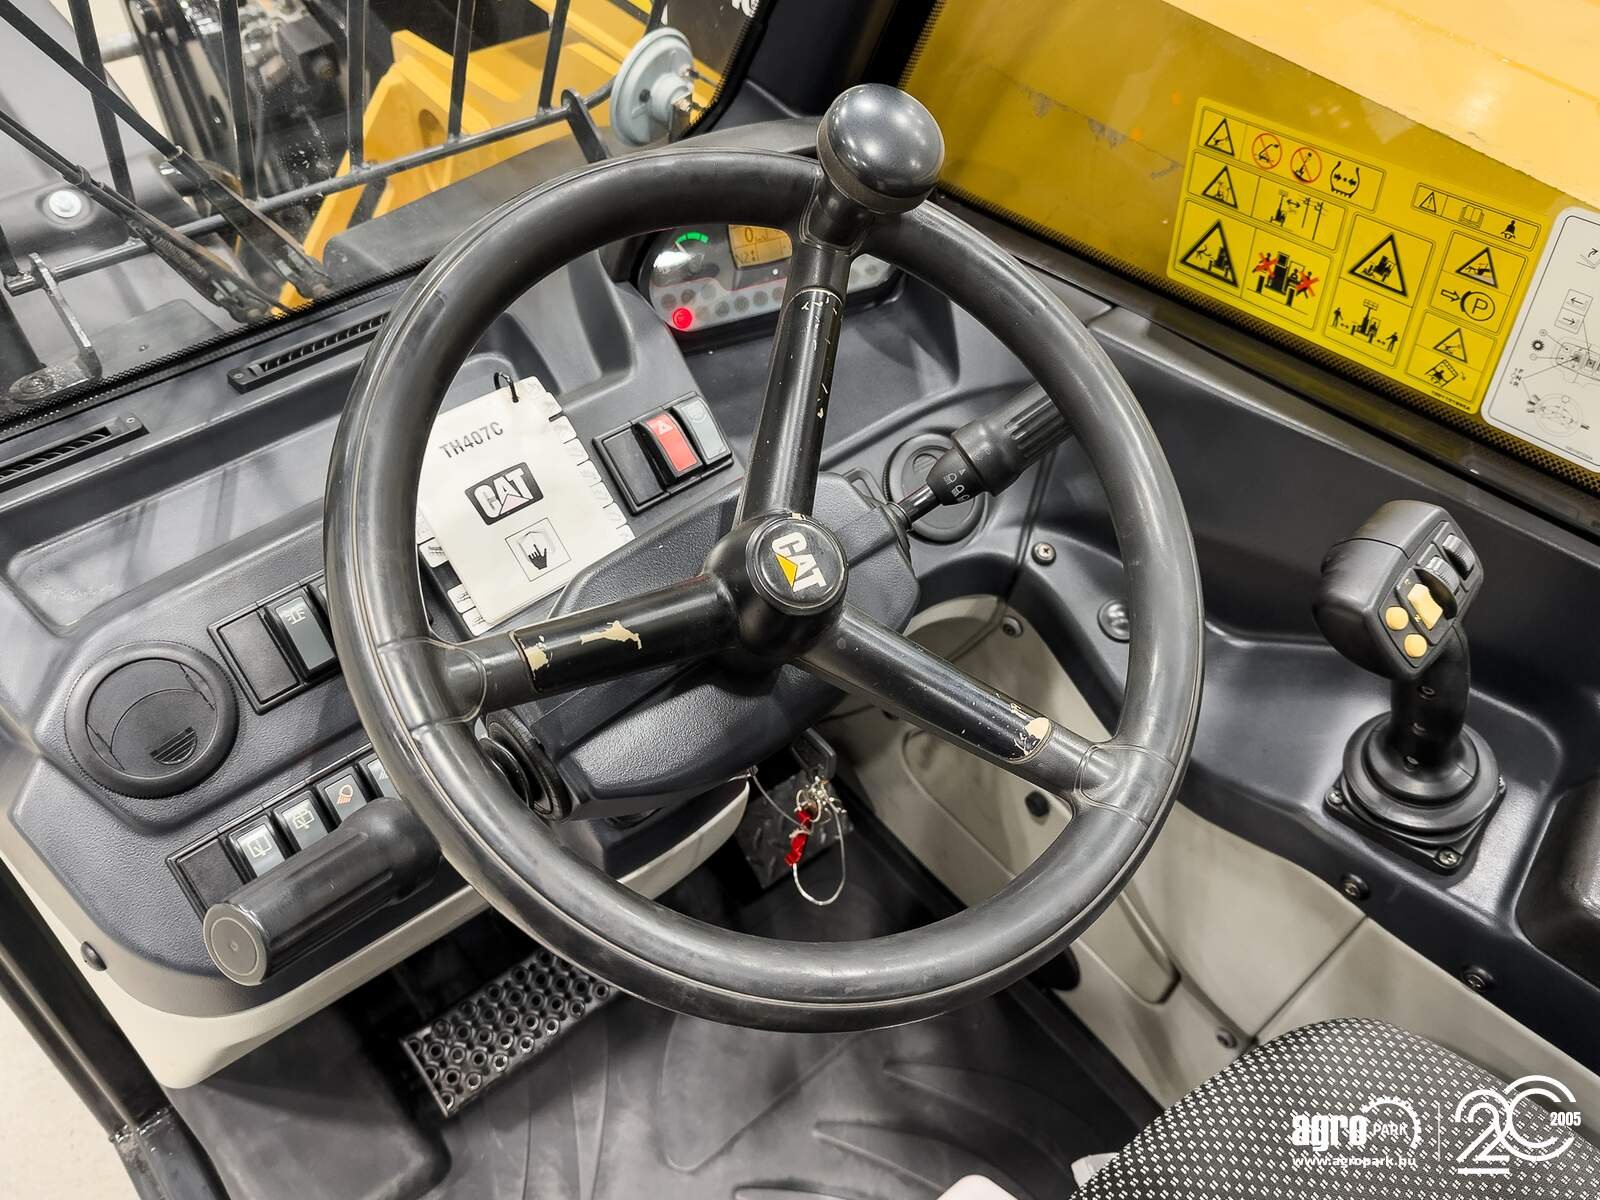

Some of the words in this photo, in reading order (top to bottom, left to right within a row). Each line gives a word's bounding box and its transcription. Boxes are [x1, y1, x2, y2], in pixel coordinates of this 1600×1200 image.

[1471, 297, 1489, 314] P
[439, 421, 504, 459] TH407C
[473, 466, 535, 518] CAT
[771, 531, 828, 593] CAT
